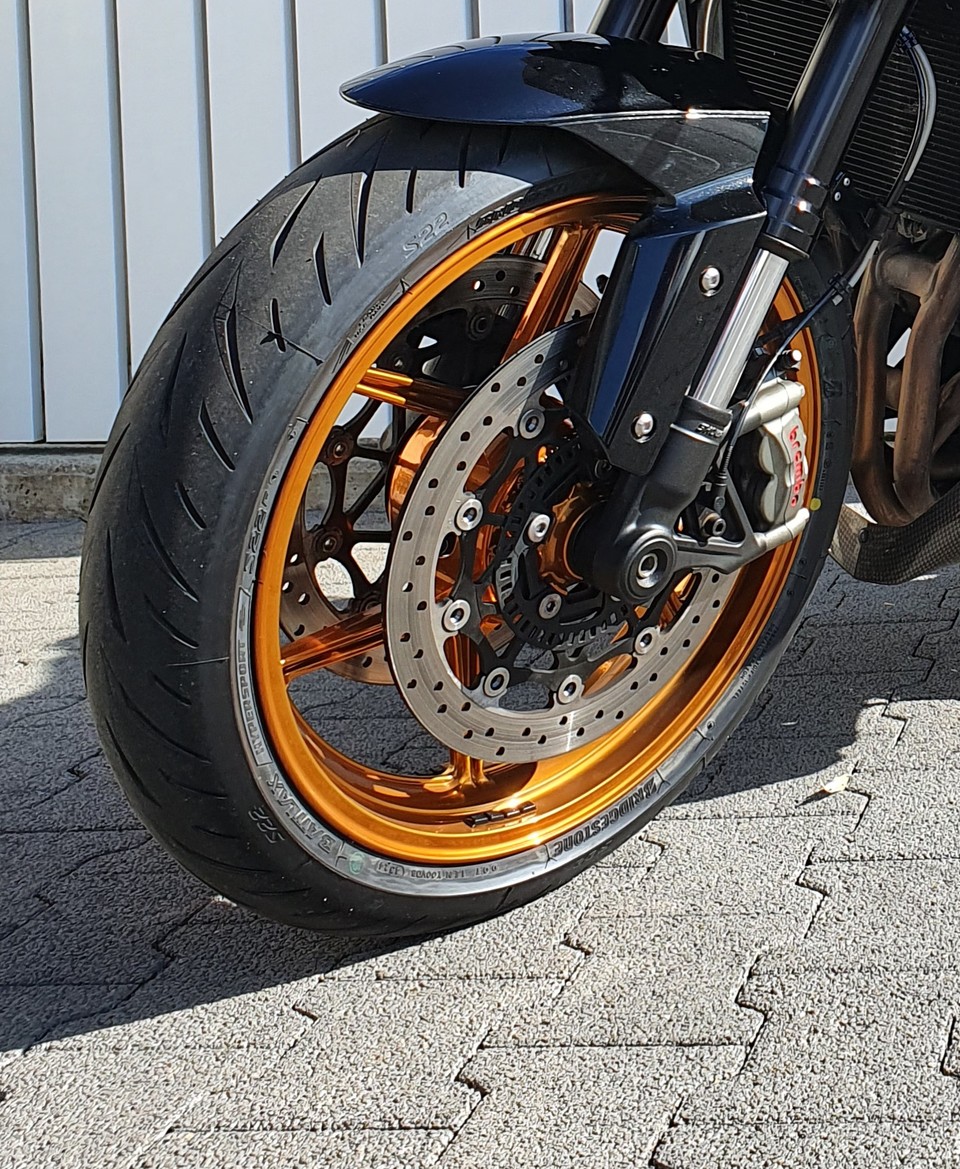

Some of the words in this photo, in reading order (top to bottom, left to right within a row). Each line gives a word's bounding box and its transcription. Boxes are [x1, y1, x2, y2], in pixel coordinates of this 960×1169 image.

[402, 211, 450, 259] S22
[788, 426, 804, 507] brembo
[248, 803, 285, 844] S22
[267, 773, 335, 853] BATTLAX
[552, 776, 658, 856] BRIDGESTONE
